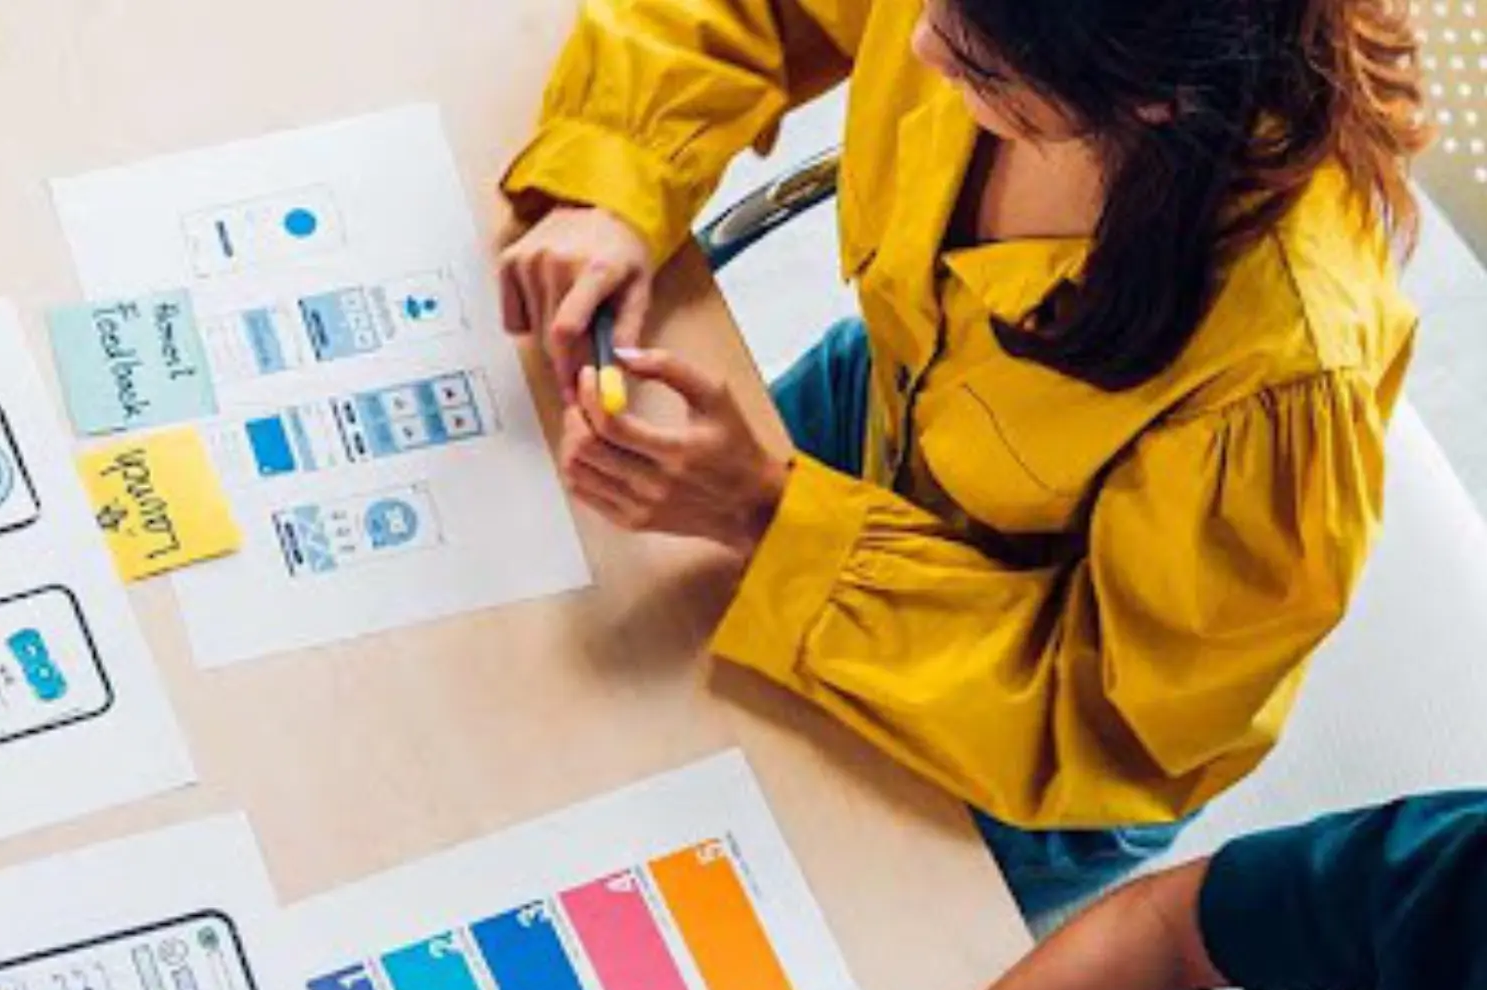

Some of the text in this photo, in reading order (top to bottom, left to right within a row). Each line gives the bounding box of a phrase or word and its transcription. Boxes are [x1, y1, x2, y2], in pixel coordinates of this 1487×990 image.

[92, 301, 151, 420] Feedback
[152, 301, 197, 381] Honest
[100, 446, 181, 560] Launch
